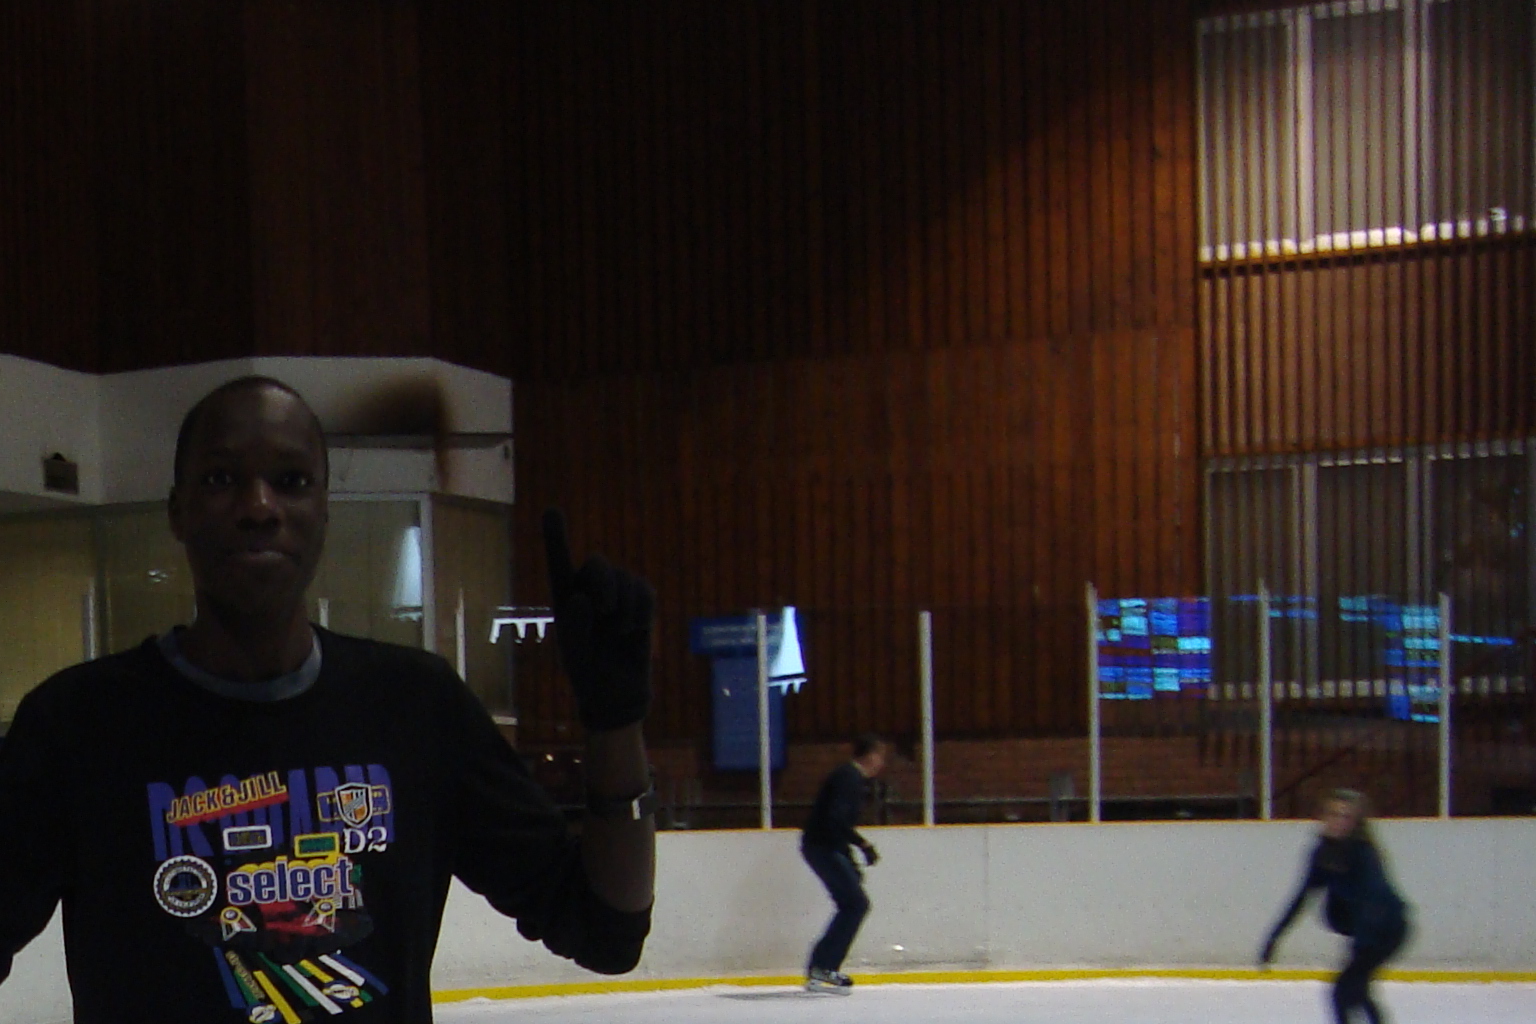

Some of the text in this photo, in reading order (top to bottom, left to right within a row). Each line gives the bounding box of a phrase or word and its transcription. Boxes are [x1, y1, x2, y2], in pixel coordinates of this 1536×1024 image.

[166, 771, 287, 823] JACK&JILL
[343, 826, 388, 853] D2
[227, 857, 352, 904] select
